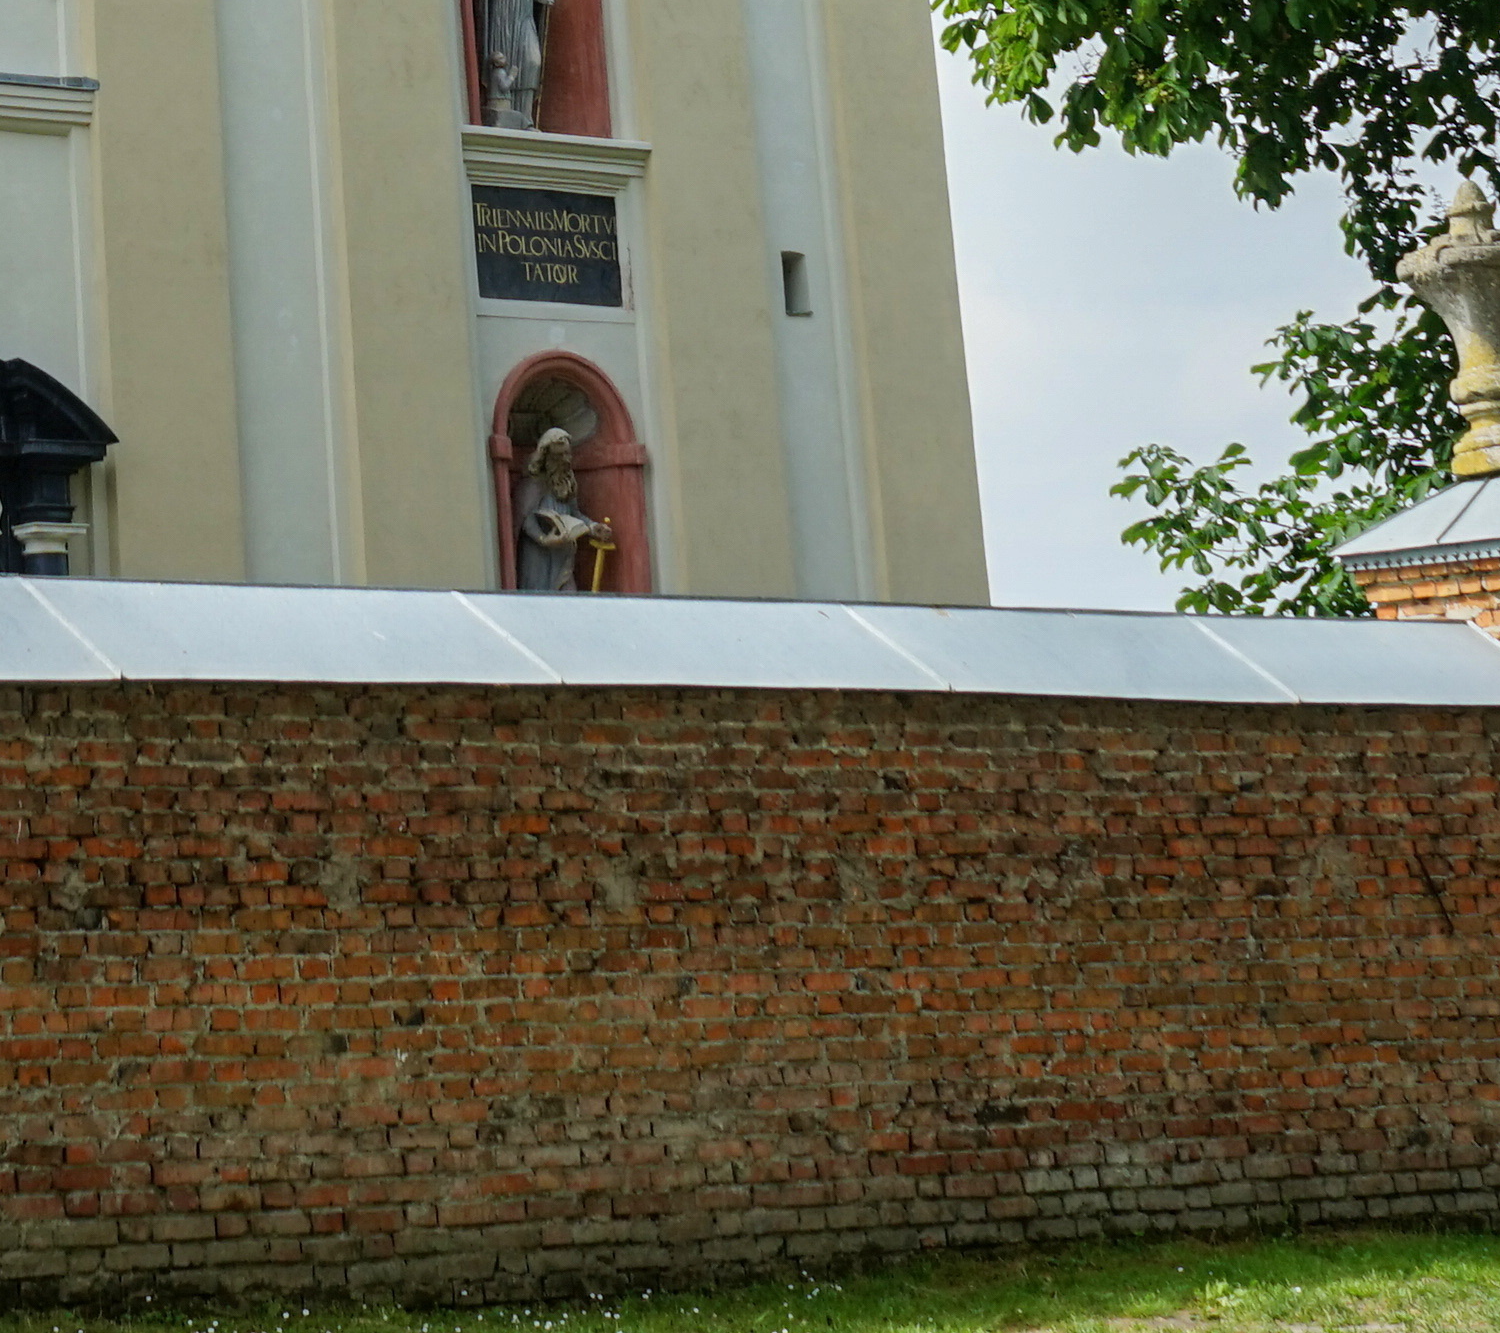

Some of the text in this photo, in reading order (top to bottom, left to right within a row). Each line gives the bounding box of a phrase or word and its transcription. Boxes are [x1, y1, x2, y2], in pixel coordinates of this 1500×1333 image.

[477, 230, 617, 261] IN POLONIA SVSCI
